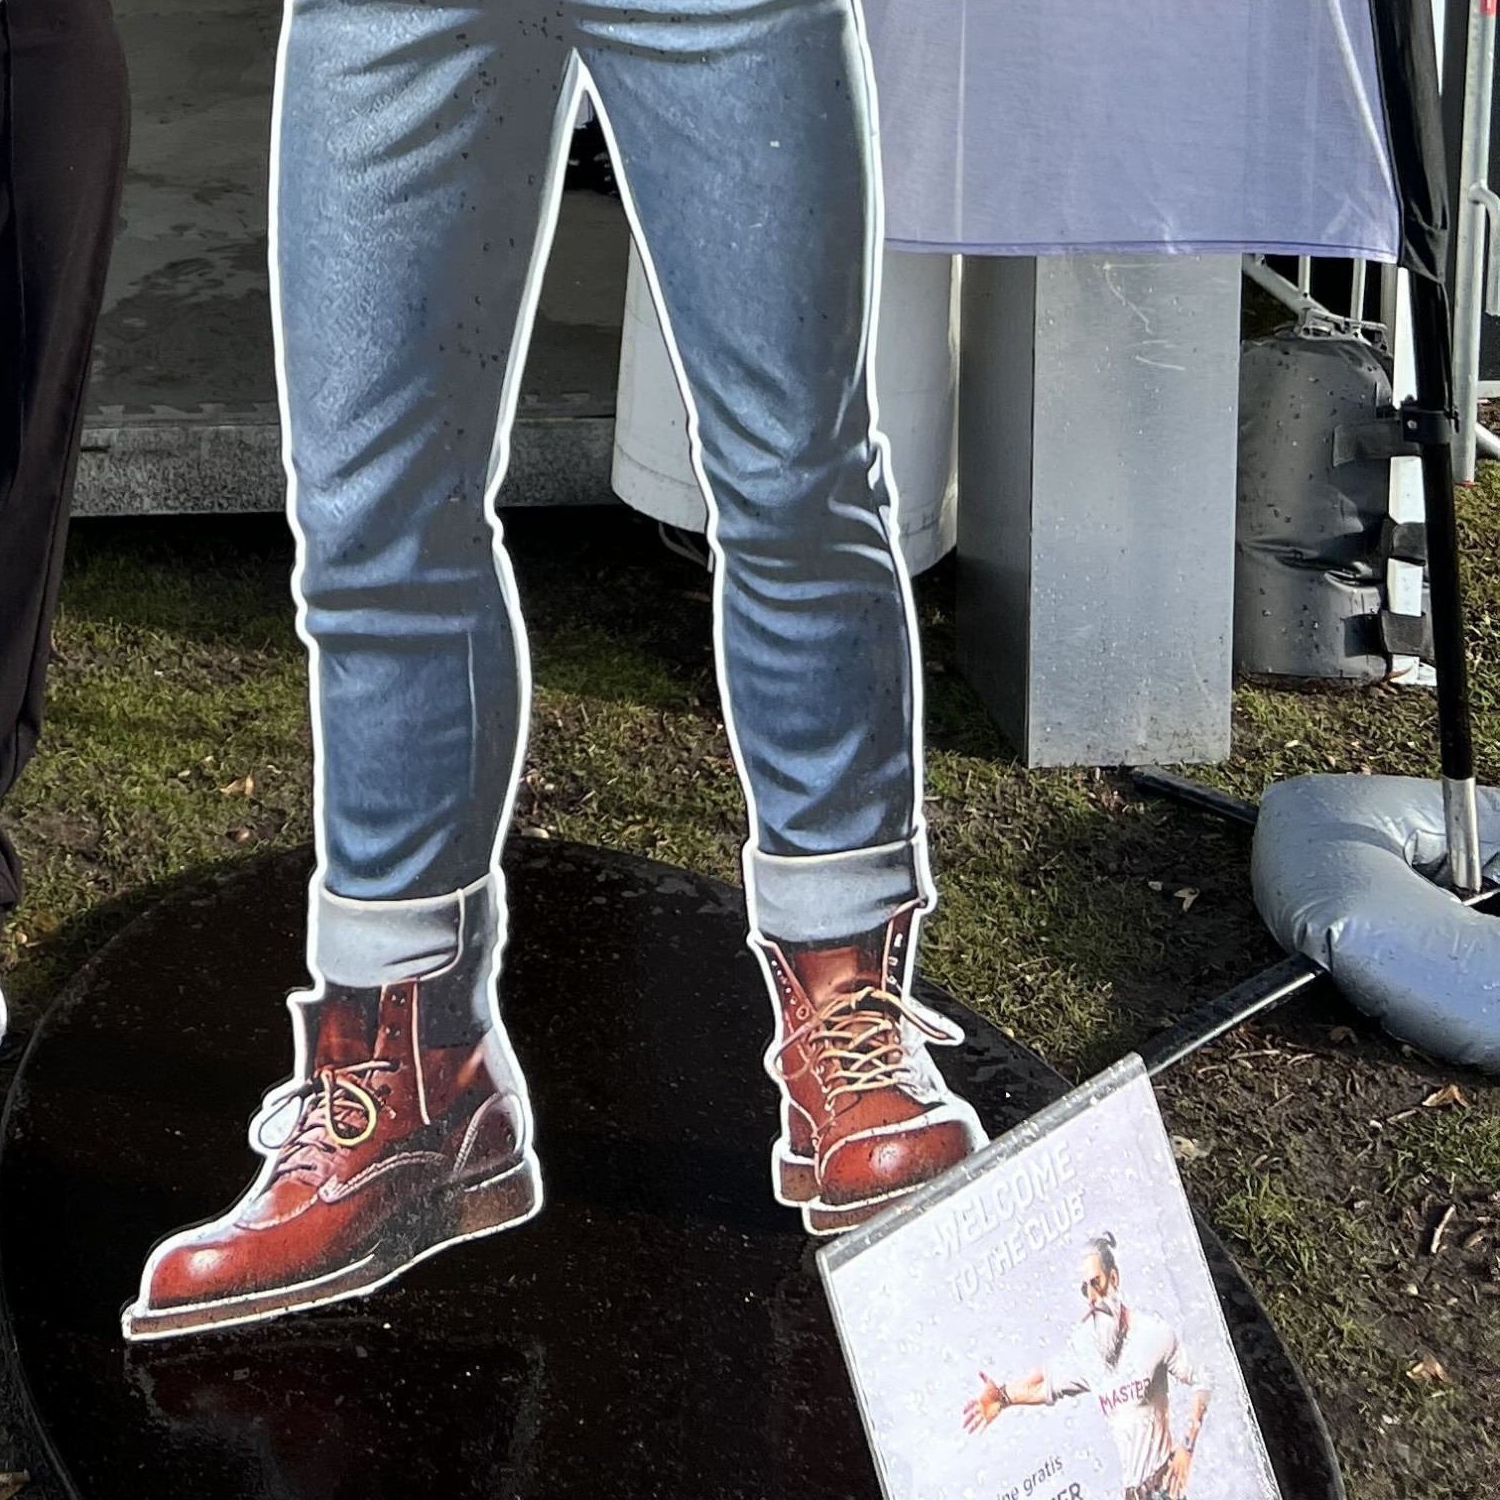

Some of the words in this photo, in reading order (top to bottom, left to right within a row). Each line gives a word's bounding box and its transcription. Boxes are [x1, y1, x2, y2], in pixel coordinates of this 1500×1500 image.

[931, 1142, 1078, 1259] WELCOME
[1023, 1193, 1087, 1252] CLUB
[1022, 1455, 1064, 1497] gratis
